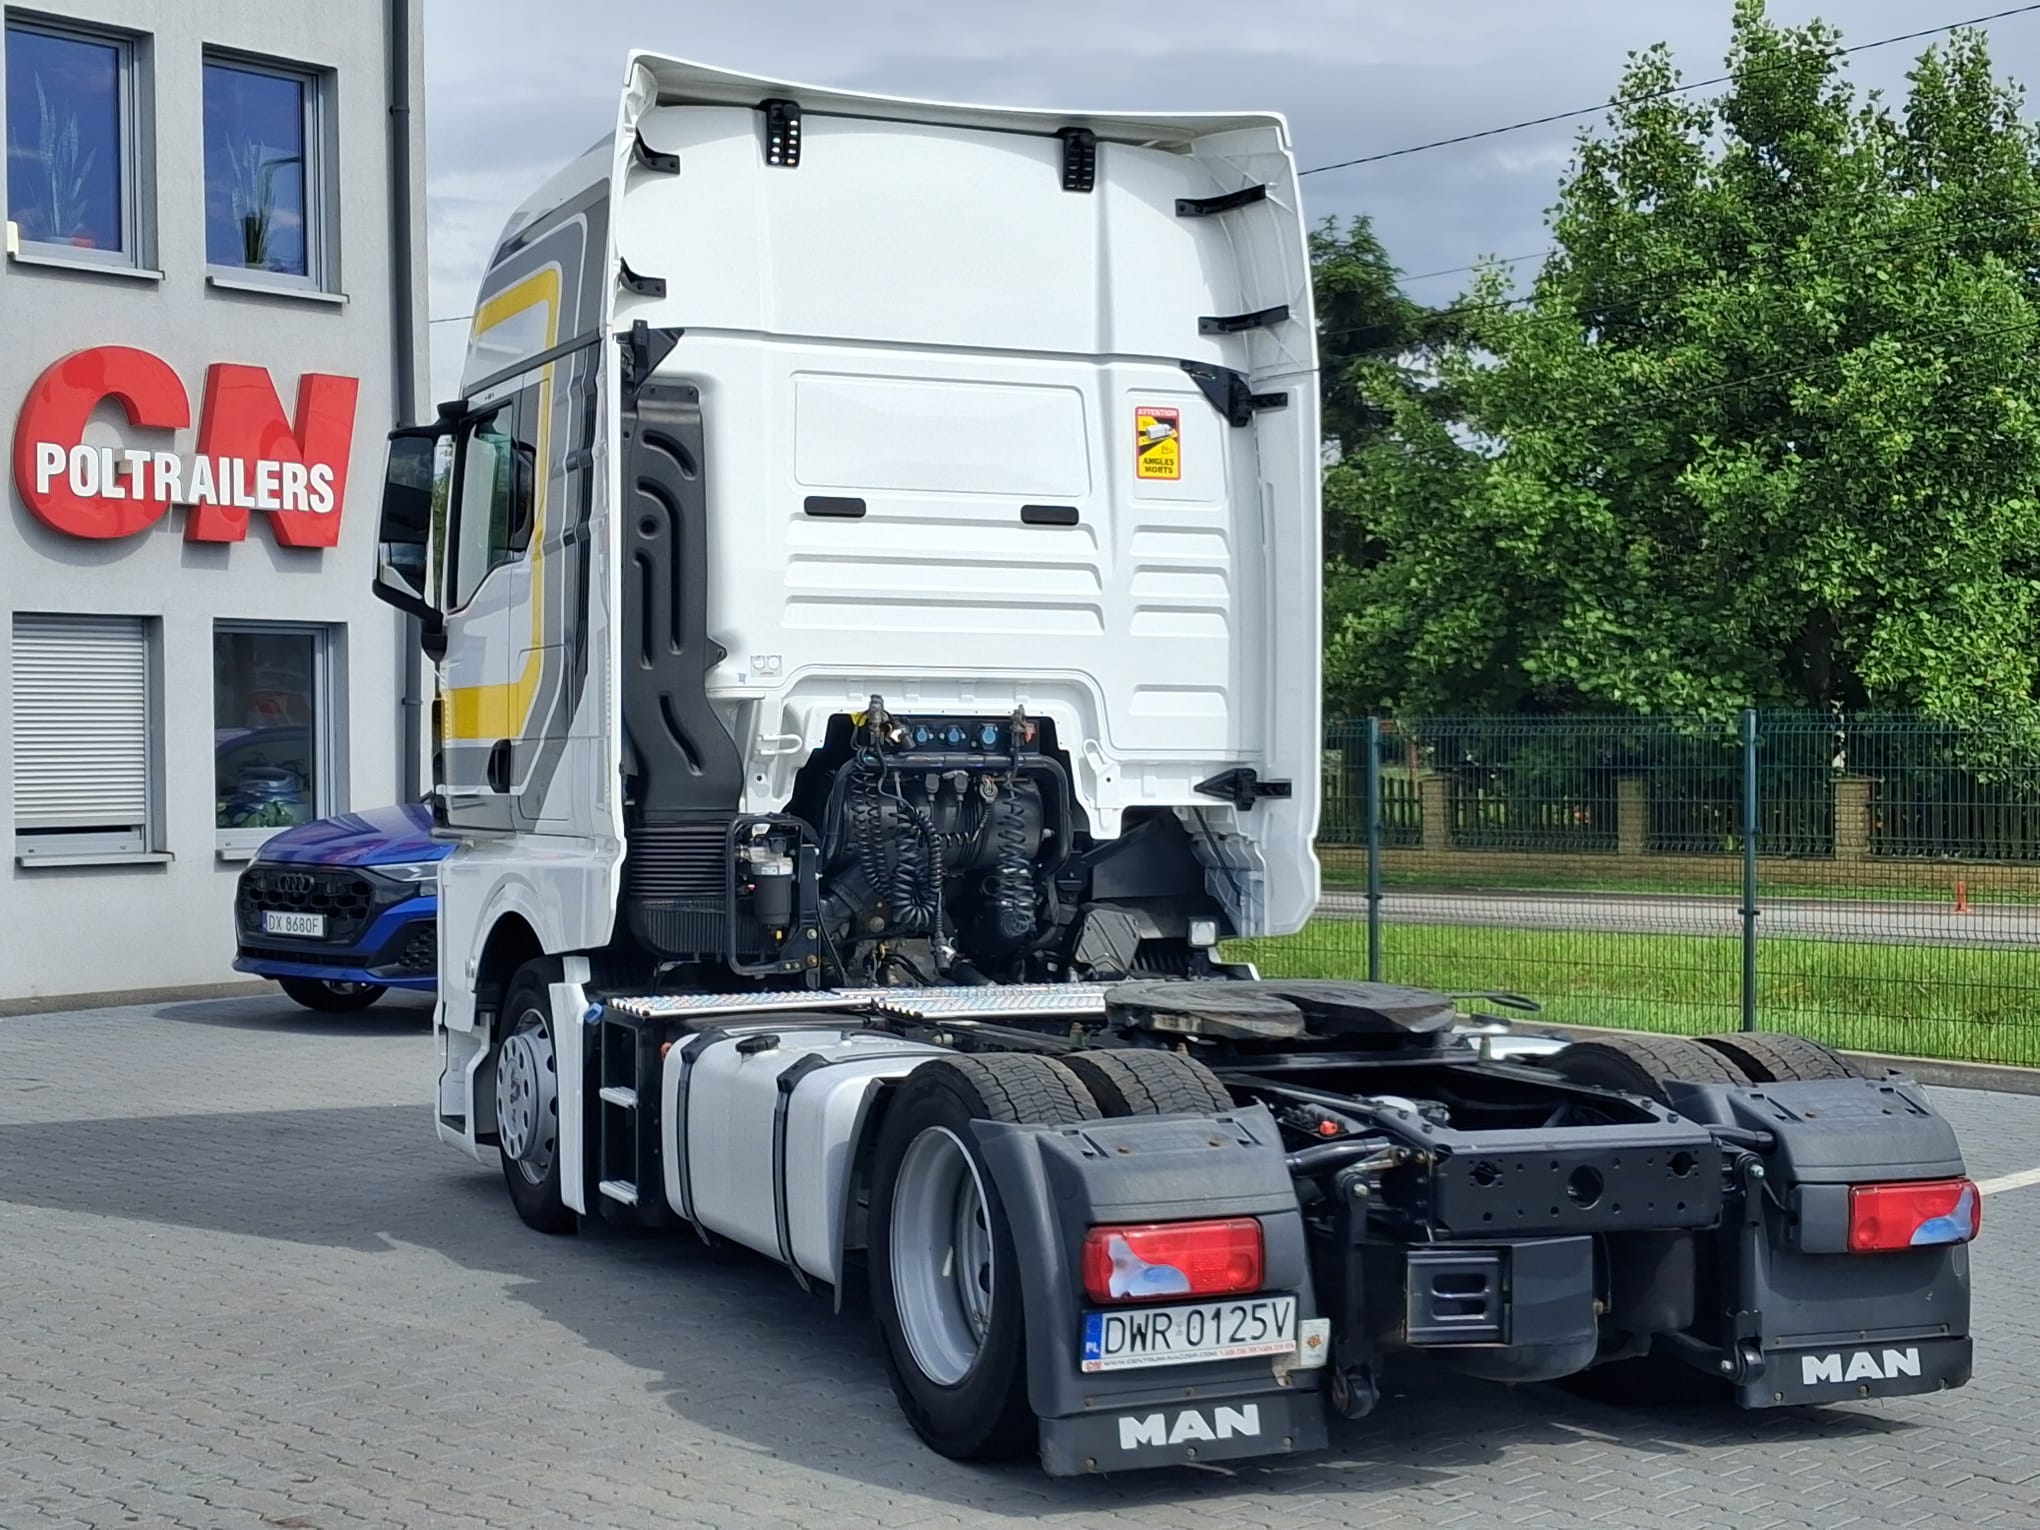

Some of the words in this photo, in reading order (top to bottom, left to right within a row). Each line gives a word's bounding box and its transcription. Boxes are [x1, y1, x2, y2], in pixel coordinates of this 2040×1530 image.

[1143, 457, 1174, 466] ANGLES
[1145, 466, 1173, 474] MORTS
[36, 442, 334, 513] POLTRAILERS
[269, 914, 282, 930] DX
[1105, 1312, 1173, 1354] DWR
[1186, 1301, 1291, 1346] 0125V
[1085, 1342, 1100, 1353] PL
[1802, 1348, 1921, 1385] MAN
[1118, 1404, 1261, 1450] MAN
